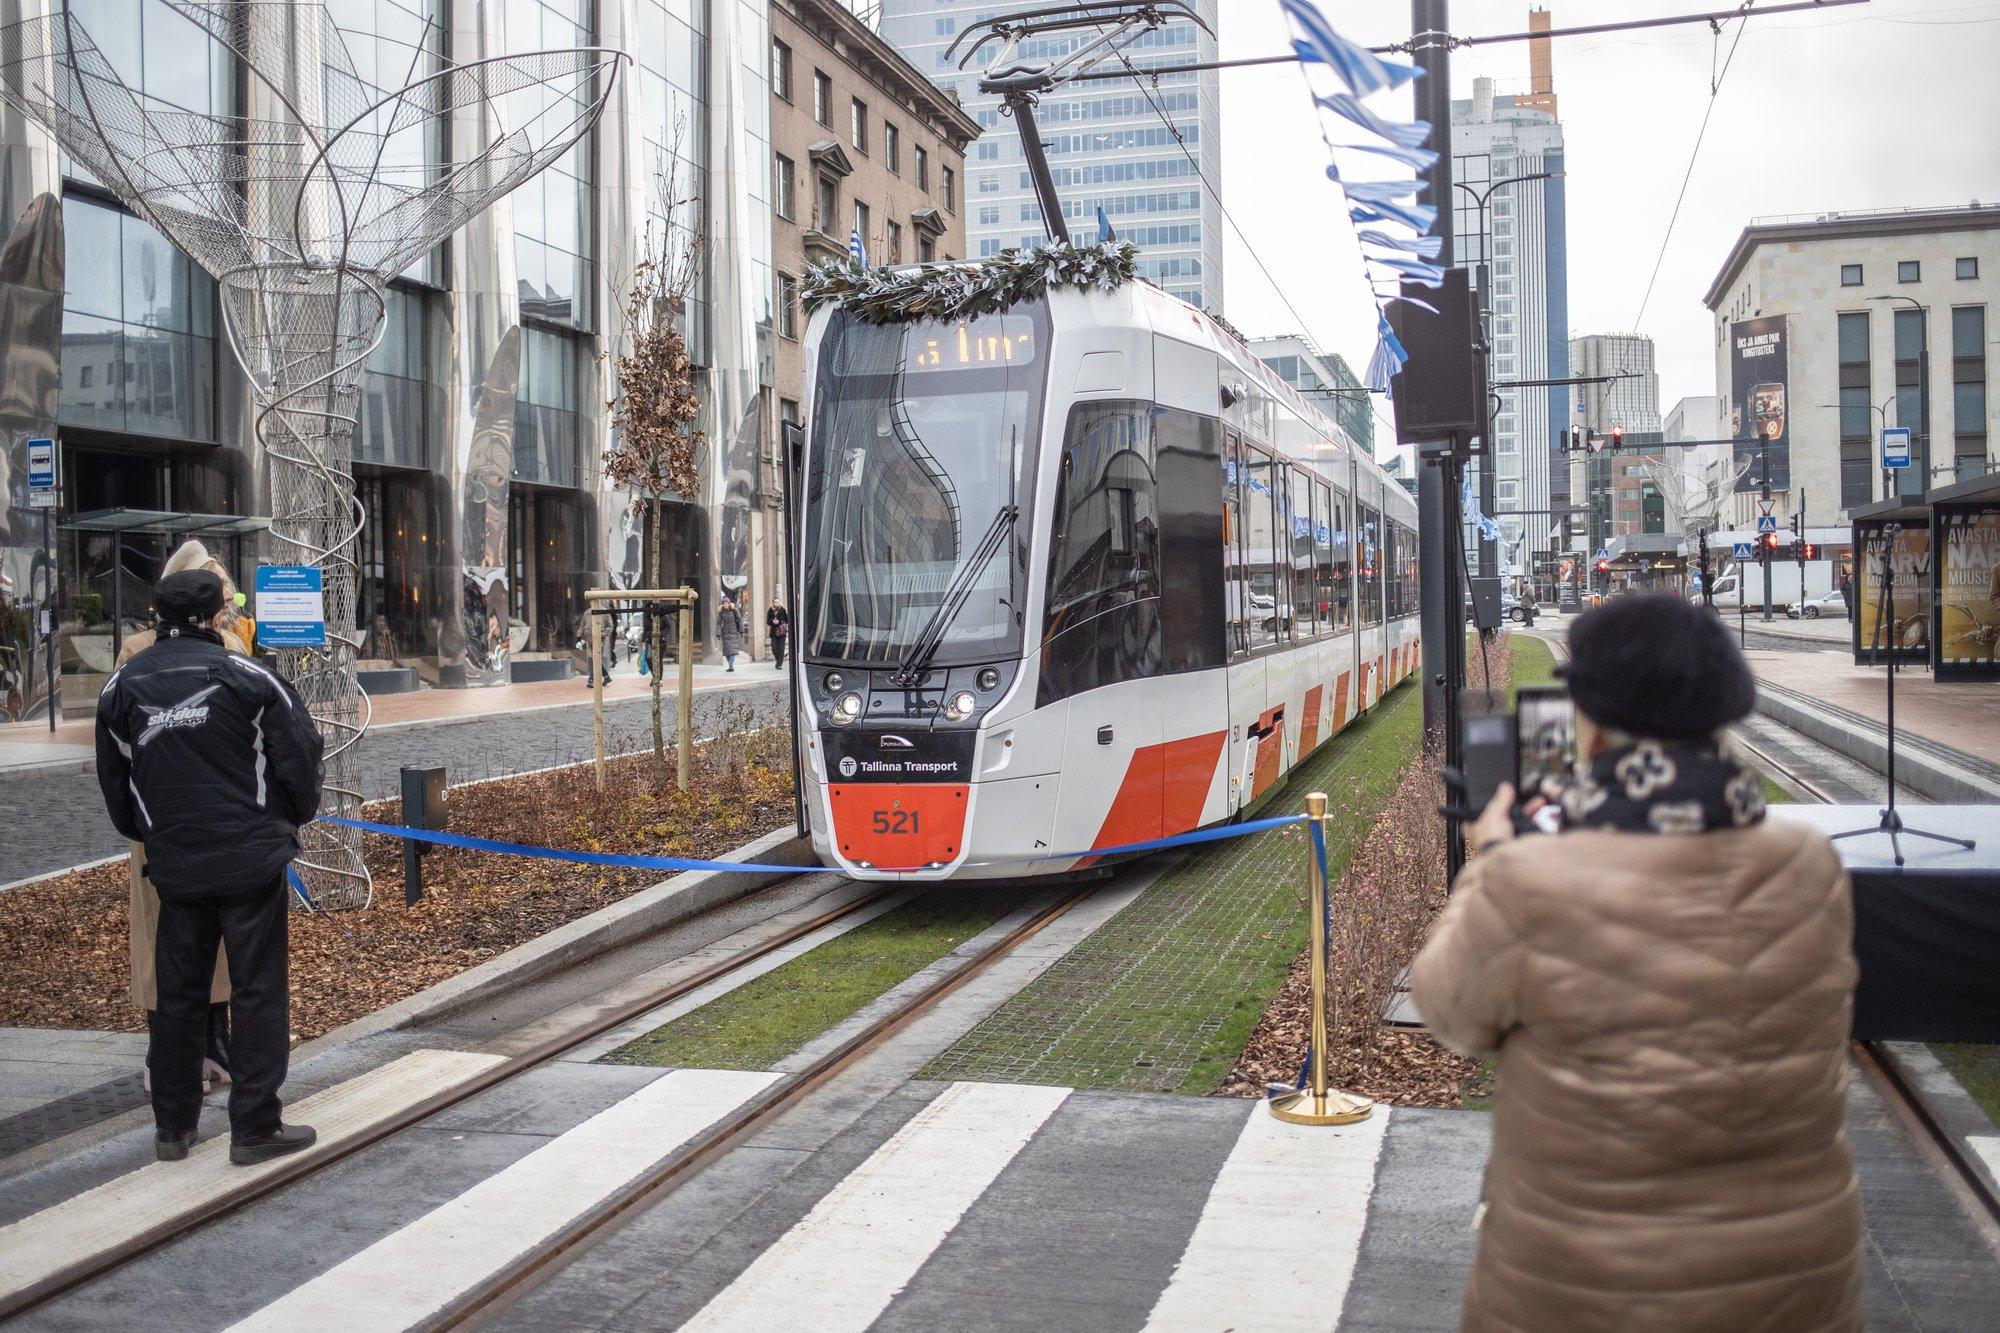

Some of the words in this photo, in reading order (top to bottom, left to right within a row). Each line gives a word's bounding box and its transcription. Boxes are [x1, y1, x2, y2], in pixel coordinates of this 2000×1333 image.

[1948, 528, 1998, 543] AVASTA
[1867, 540, 1907, 553] AVATA
[1866, 551, 1931, 574] NARV
[1867, 574, 1918, 587] MUEUMI
[860, 761, 902, 772] Tallinna
[904, 761, 958, 774] Transport
[873, 811, 920, 835] 521
